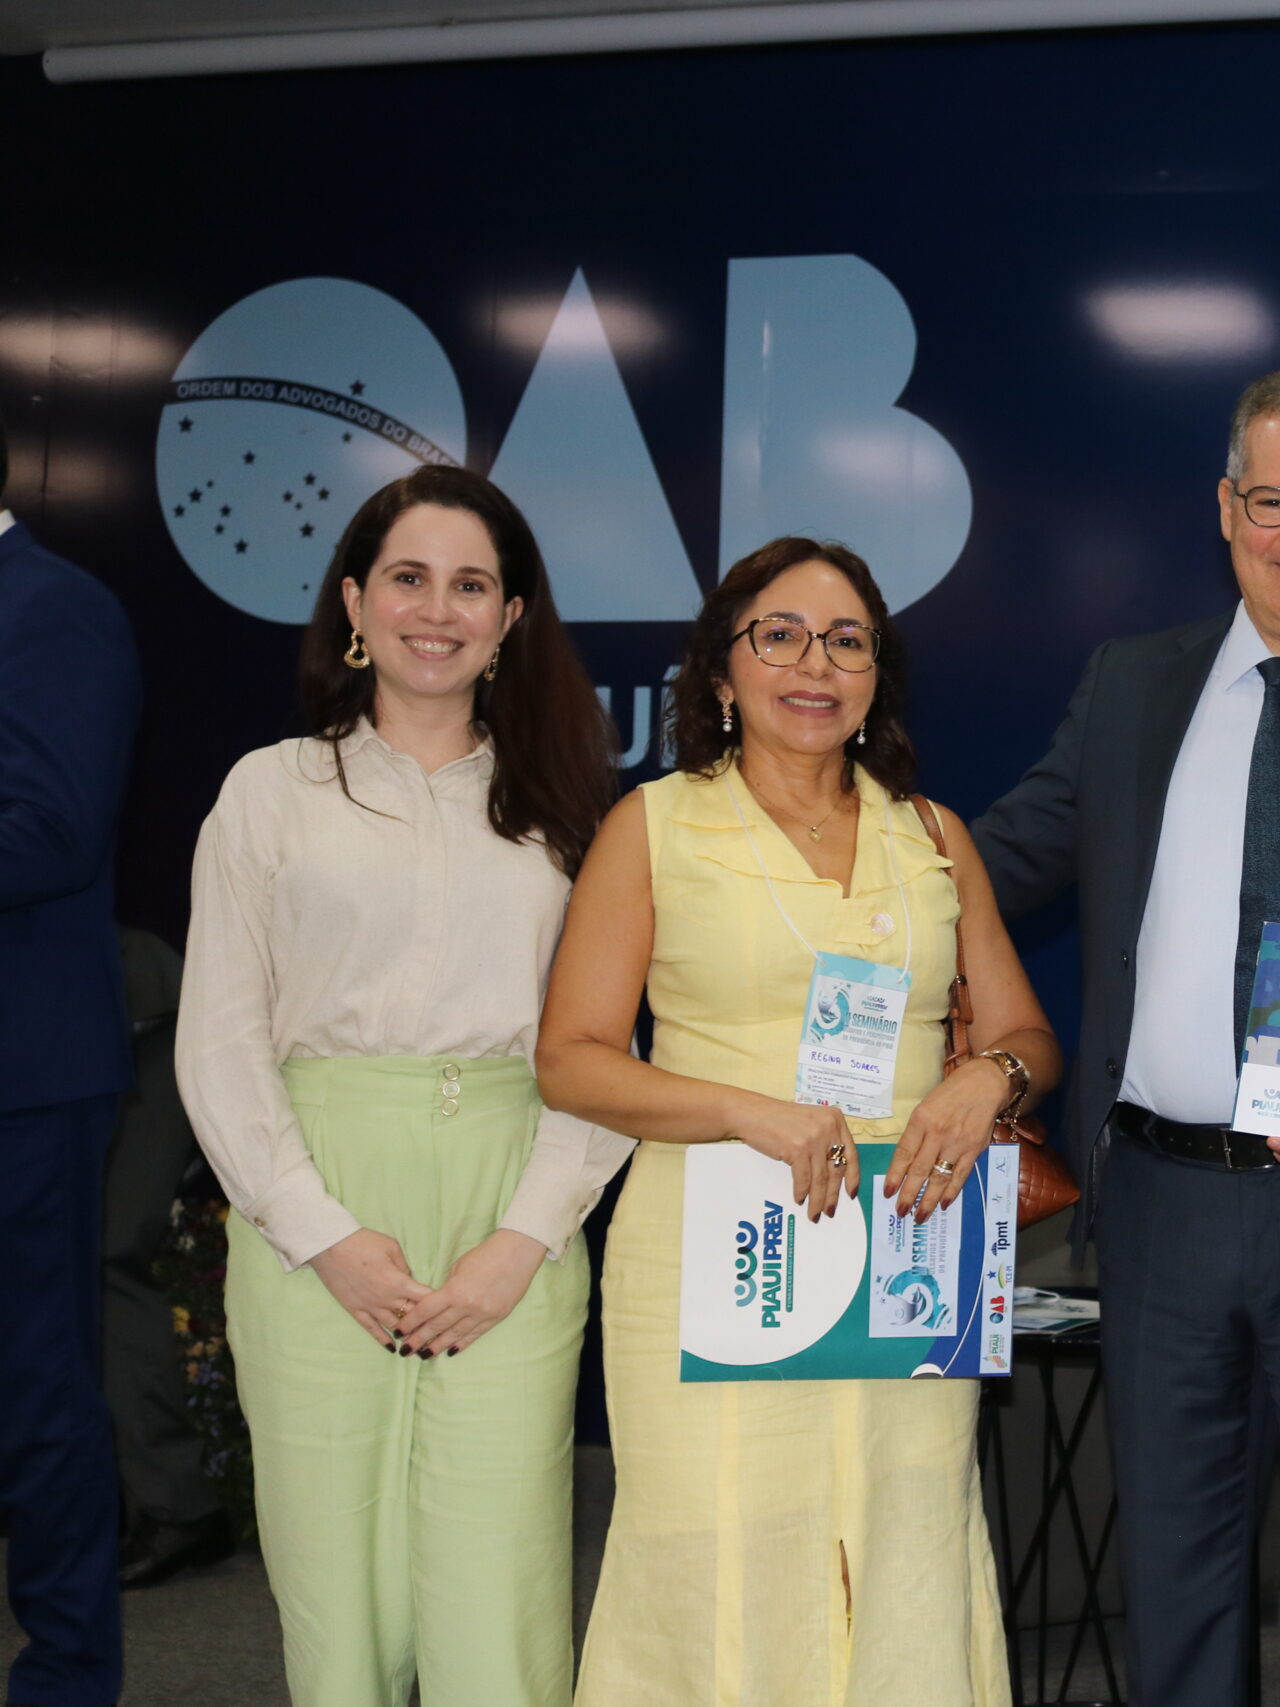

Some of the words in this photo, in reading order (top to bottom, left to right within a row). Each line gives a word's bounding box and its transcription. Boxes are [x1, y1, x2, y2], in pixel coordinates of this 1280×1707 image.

[156, 254, 972, 625] OAB
[177, 380, 236, 399] ORDEM
[239, 381, 275, 399] DOS
[277, 384, 381, 429] ADVOGADOS
[382, 420, 408, 442] DO
[408, 435, 453, 467] BRAS
[852, 1012, 898, 1034] SEMINÁRIO
[810, 1051, 841, 1064] REGINA
[850, 1059, 881, 1074] SOARES
[938, 1218, 946, 1262] PREVIDÊNCIA
[989, 1295, 1005, 1324] OAB
